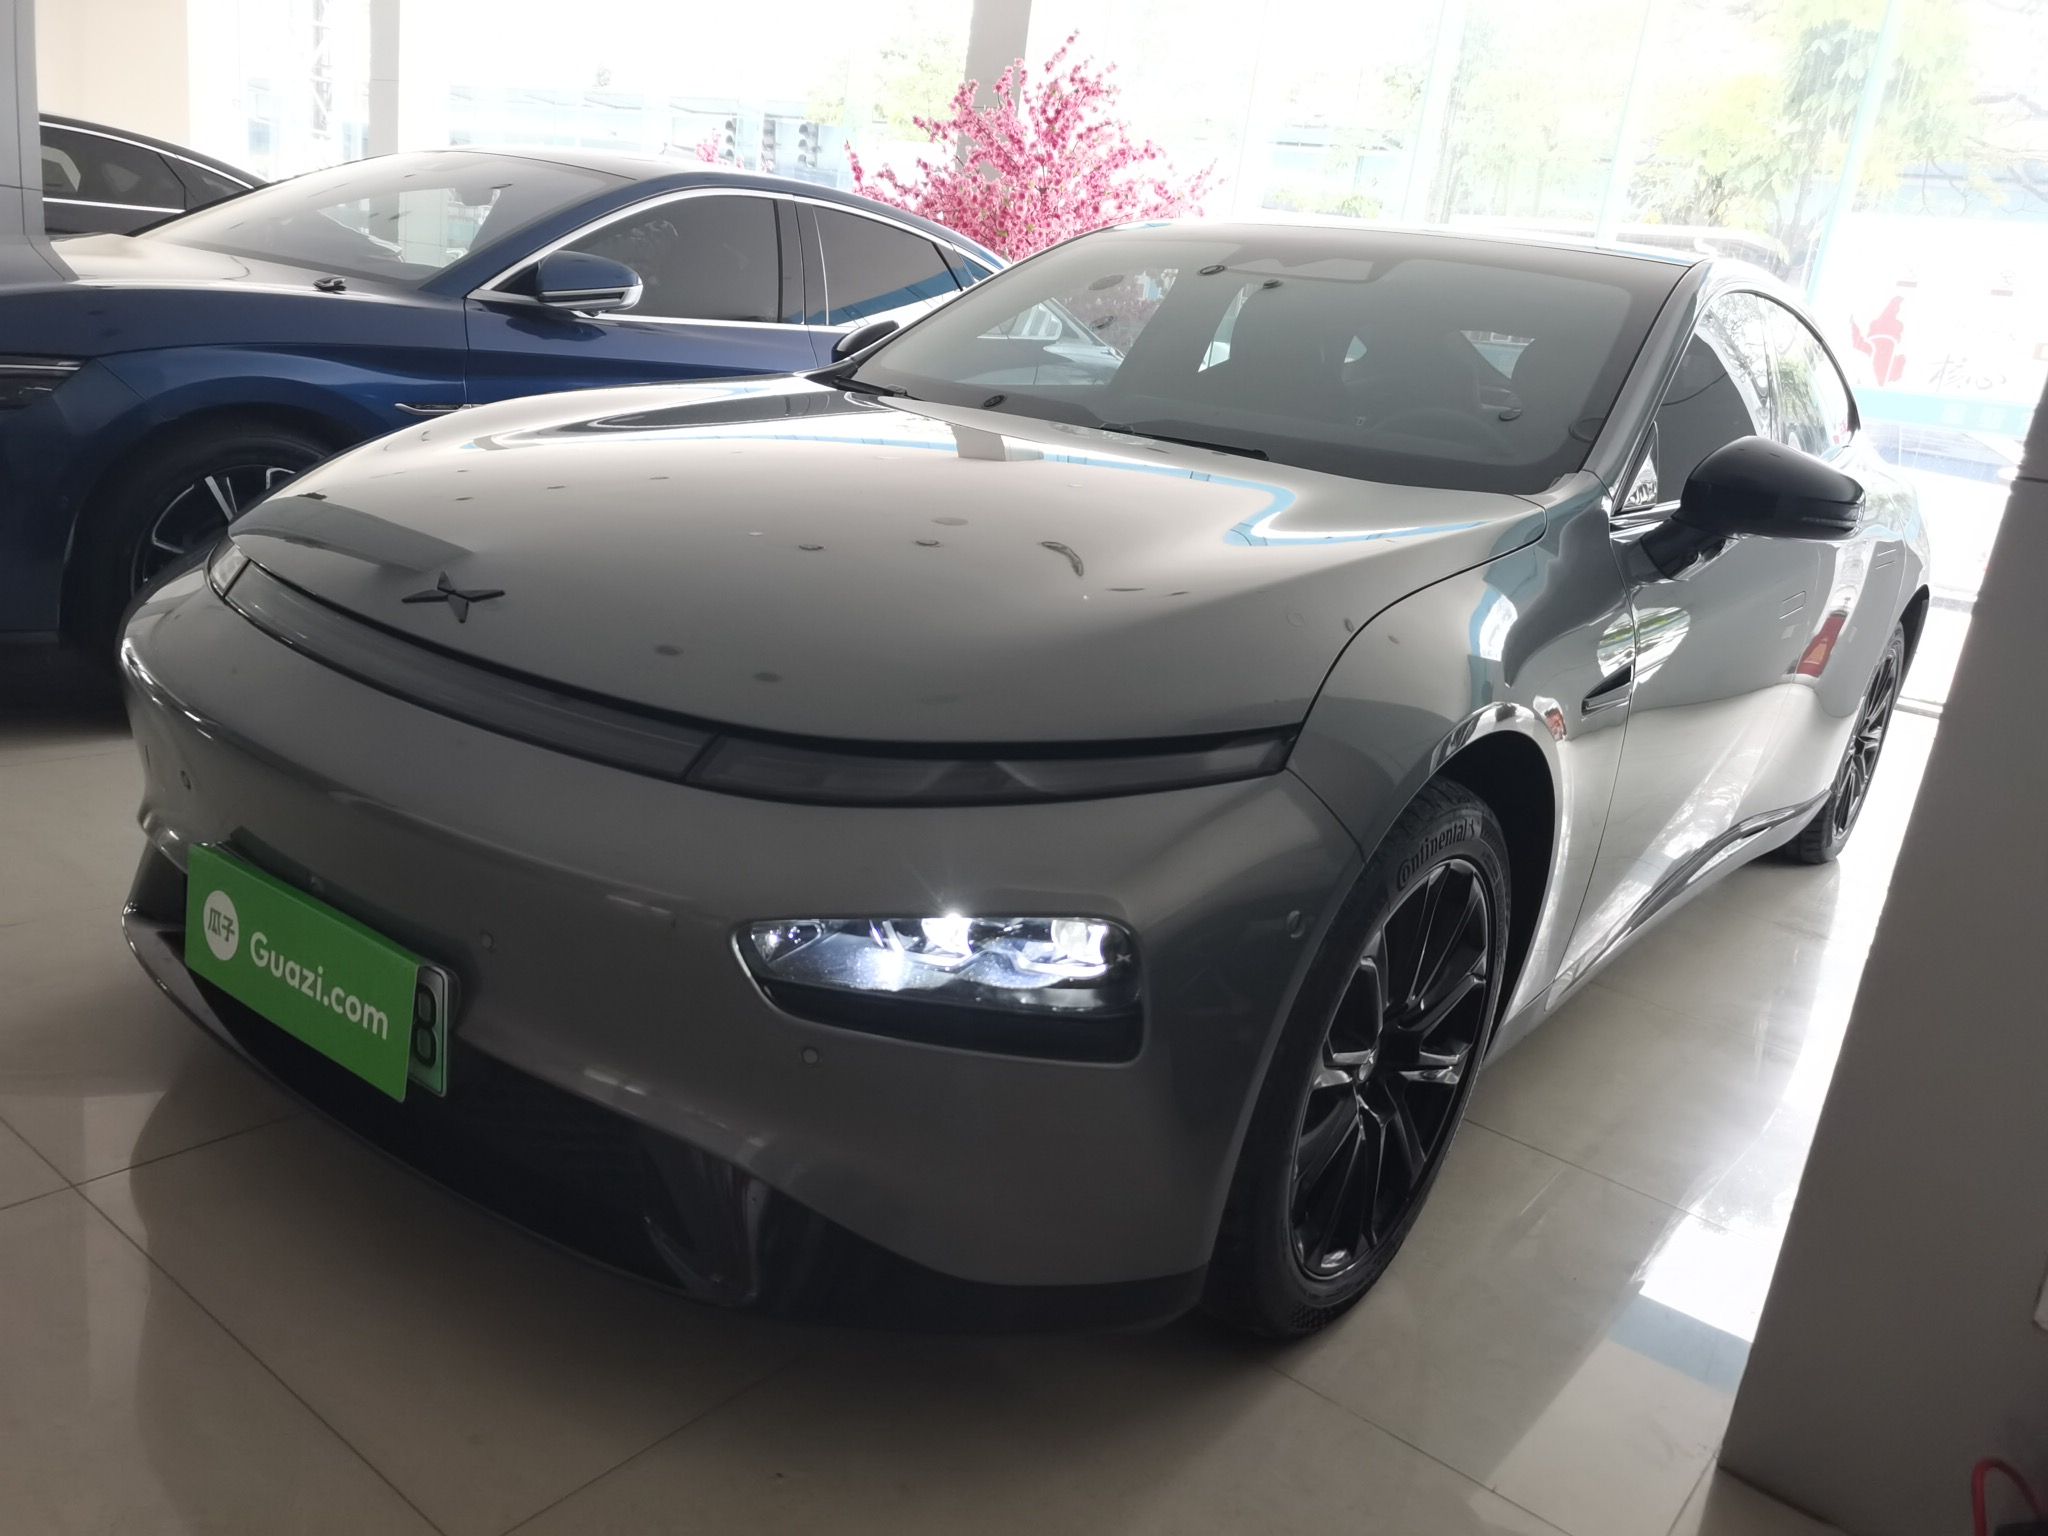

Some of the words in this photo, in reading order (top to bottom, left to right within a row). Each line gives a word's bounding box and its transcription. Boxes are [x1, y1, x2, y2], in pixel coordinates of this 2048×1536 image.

[1397, 818, 1468, 892] Continental
[208, 907, 235, 942] 瓜子
[250, 932, 388, 1040] Guazi.com
[413, 984, 437, 1069] 8
